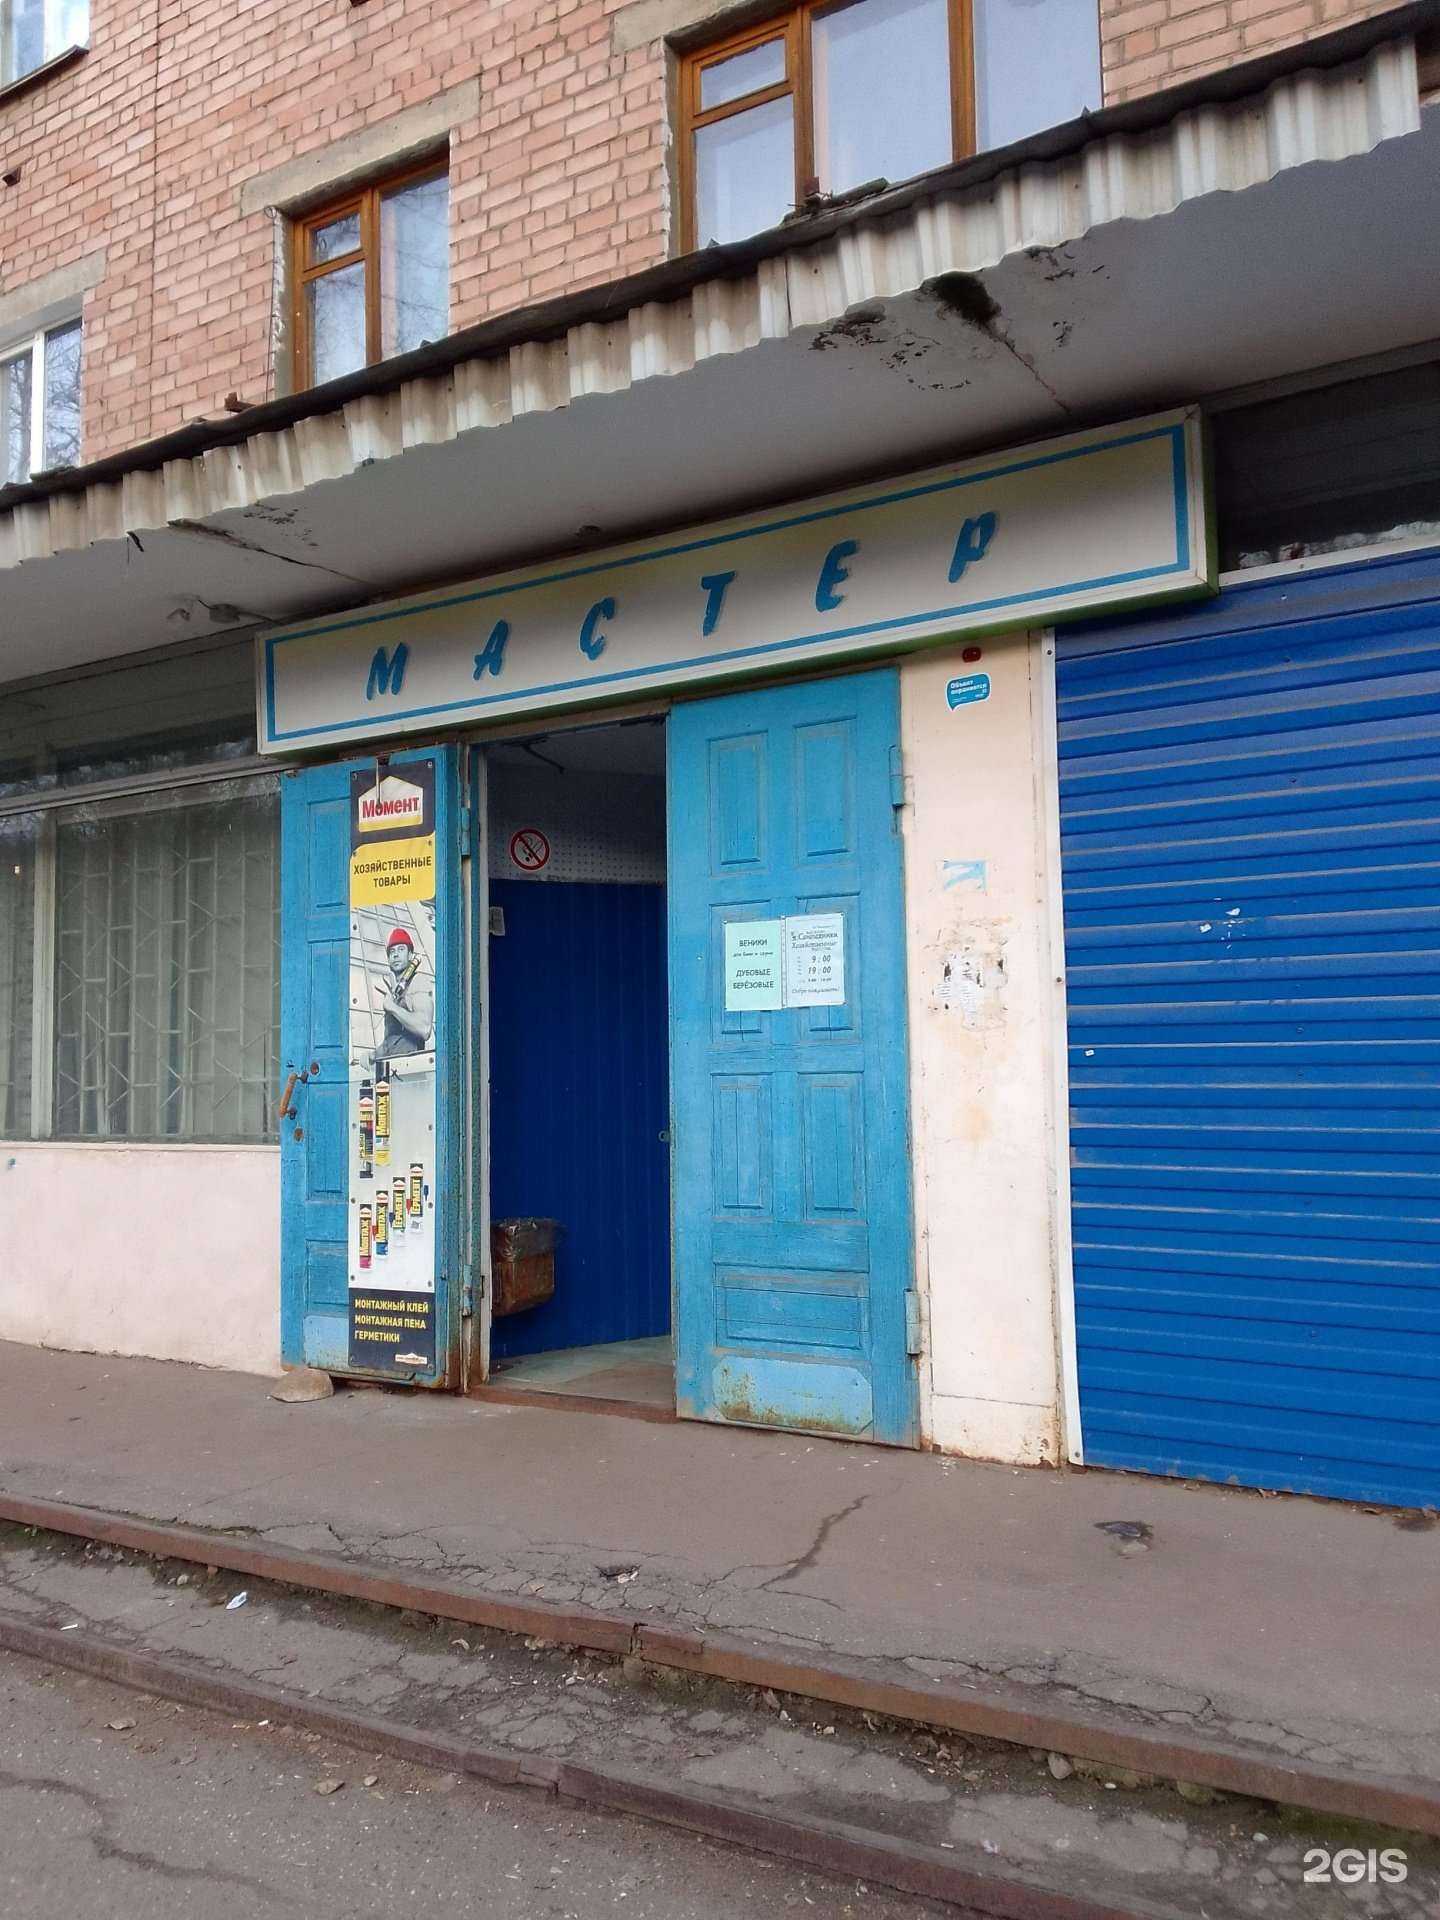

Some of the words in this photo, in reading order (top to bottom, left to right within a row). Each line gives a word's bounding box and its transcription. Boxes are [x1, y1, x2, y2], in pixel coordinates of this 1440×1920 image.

[366, 511, 998, 701] МАСТЕР
[353, 856, 432, 875] ХОЗЯЙСТВЕННЫЕ
[373, 874, 411, 888] ТОВАРЫ
[739, 939, 768, 947] ВЕНИКИ
[736, 968, 771, 978] ДУБОВЫЕ
[354, 1298, 405, 1312] МОНТАЖНЫЙ
[406, 1300, 429, 1314] КЛЕЙ
[354, 1315, 403, 1327] МОНТАЖНАЯ
[404, 1318, 427, 1329] ПЕНА
[354, 1330, 400, 1343] ГЕРМЕТИКИ
